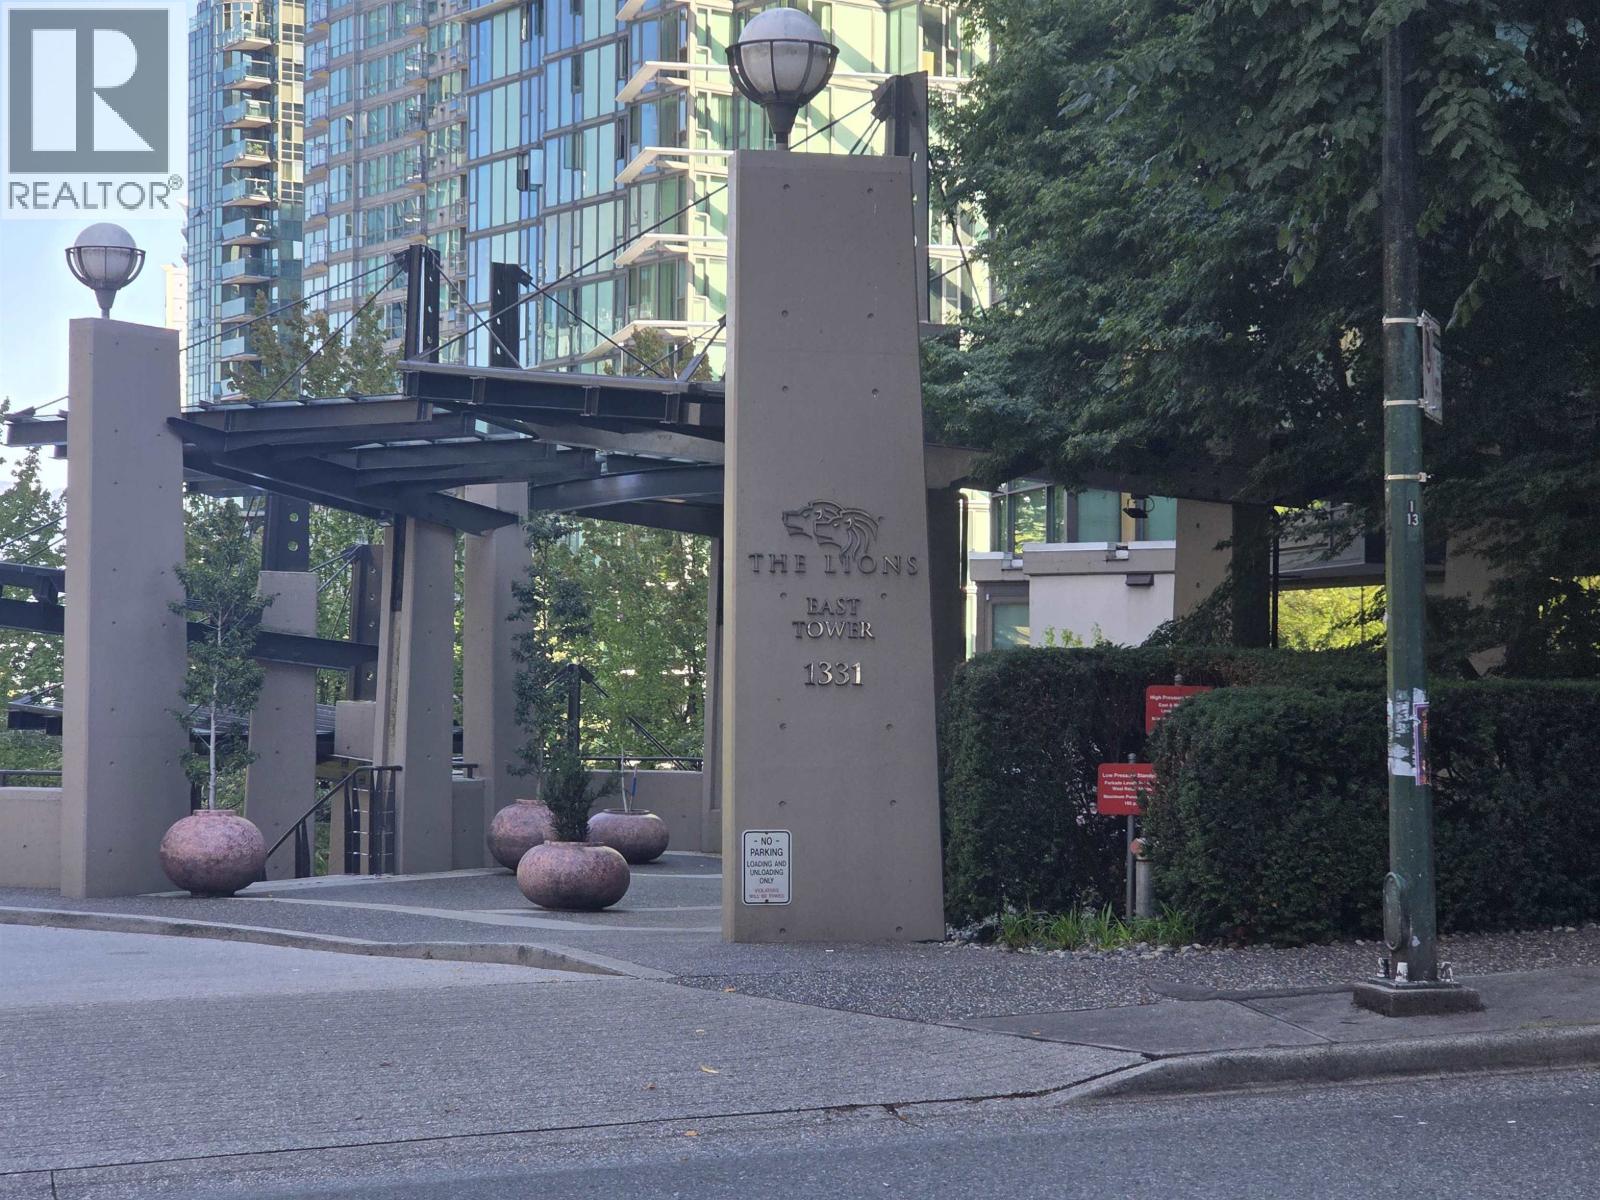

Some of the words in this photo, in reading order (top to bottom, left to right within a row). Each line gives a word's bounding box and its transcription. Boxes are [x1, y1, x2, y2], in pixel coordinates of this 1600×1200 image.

[1407, 513, 1419, 526] 13
[748, 553, 807, 574] THE
[824, 554, 918, 575] LIONS
[806, 597, 860, 616] EAST
[792, 621, 875, 639] TOWER
[804, 661, 864, 686] 1331
[761, 837, 773, 845] NO
[750, 848, 784, 856] PARKING
